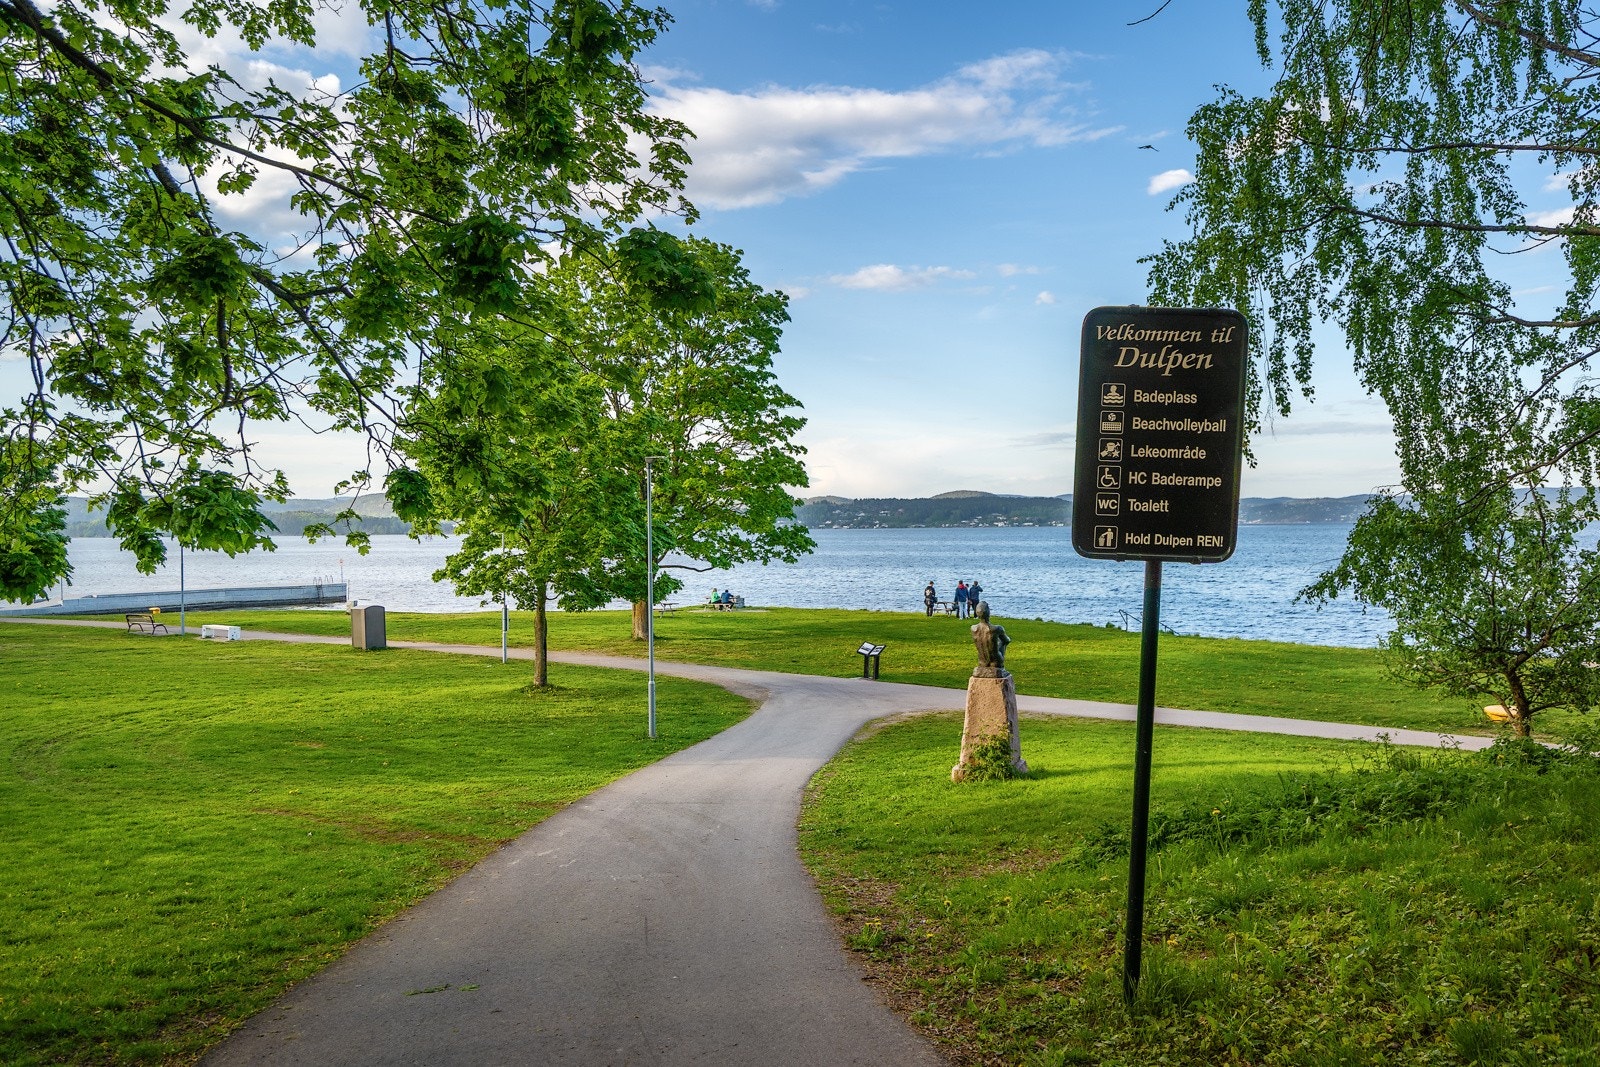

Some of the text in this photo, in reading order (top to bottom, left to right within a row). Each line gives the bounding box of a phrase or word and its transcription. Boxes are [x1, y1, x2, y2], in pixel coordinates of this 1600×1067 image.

[1096, 324, 1235, 343] Velkommen til
[1114, 345, 1213, 376] Dulpen
[1134, 390, 1197, 405] Badeplass
[1133, 417, 1226, 433] Beachvolleyball
[1131, 445, 1206, 459] Lekeområde
[1129, 472, 1221, 487] HC Baderampe
[1098, 499, 1169, 512] WC Toalett
[1126, 533, 1223, 548] Hold Dulpen REN!
